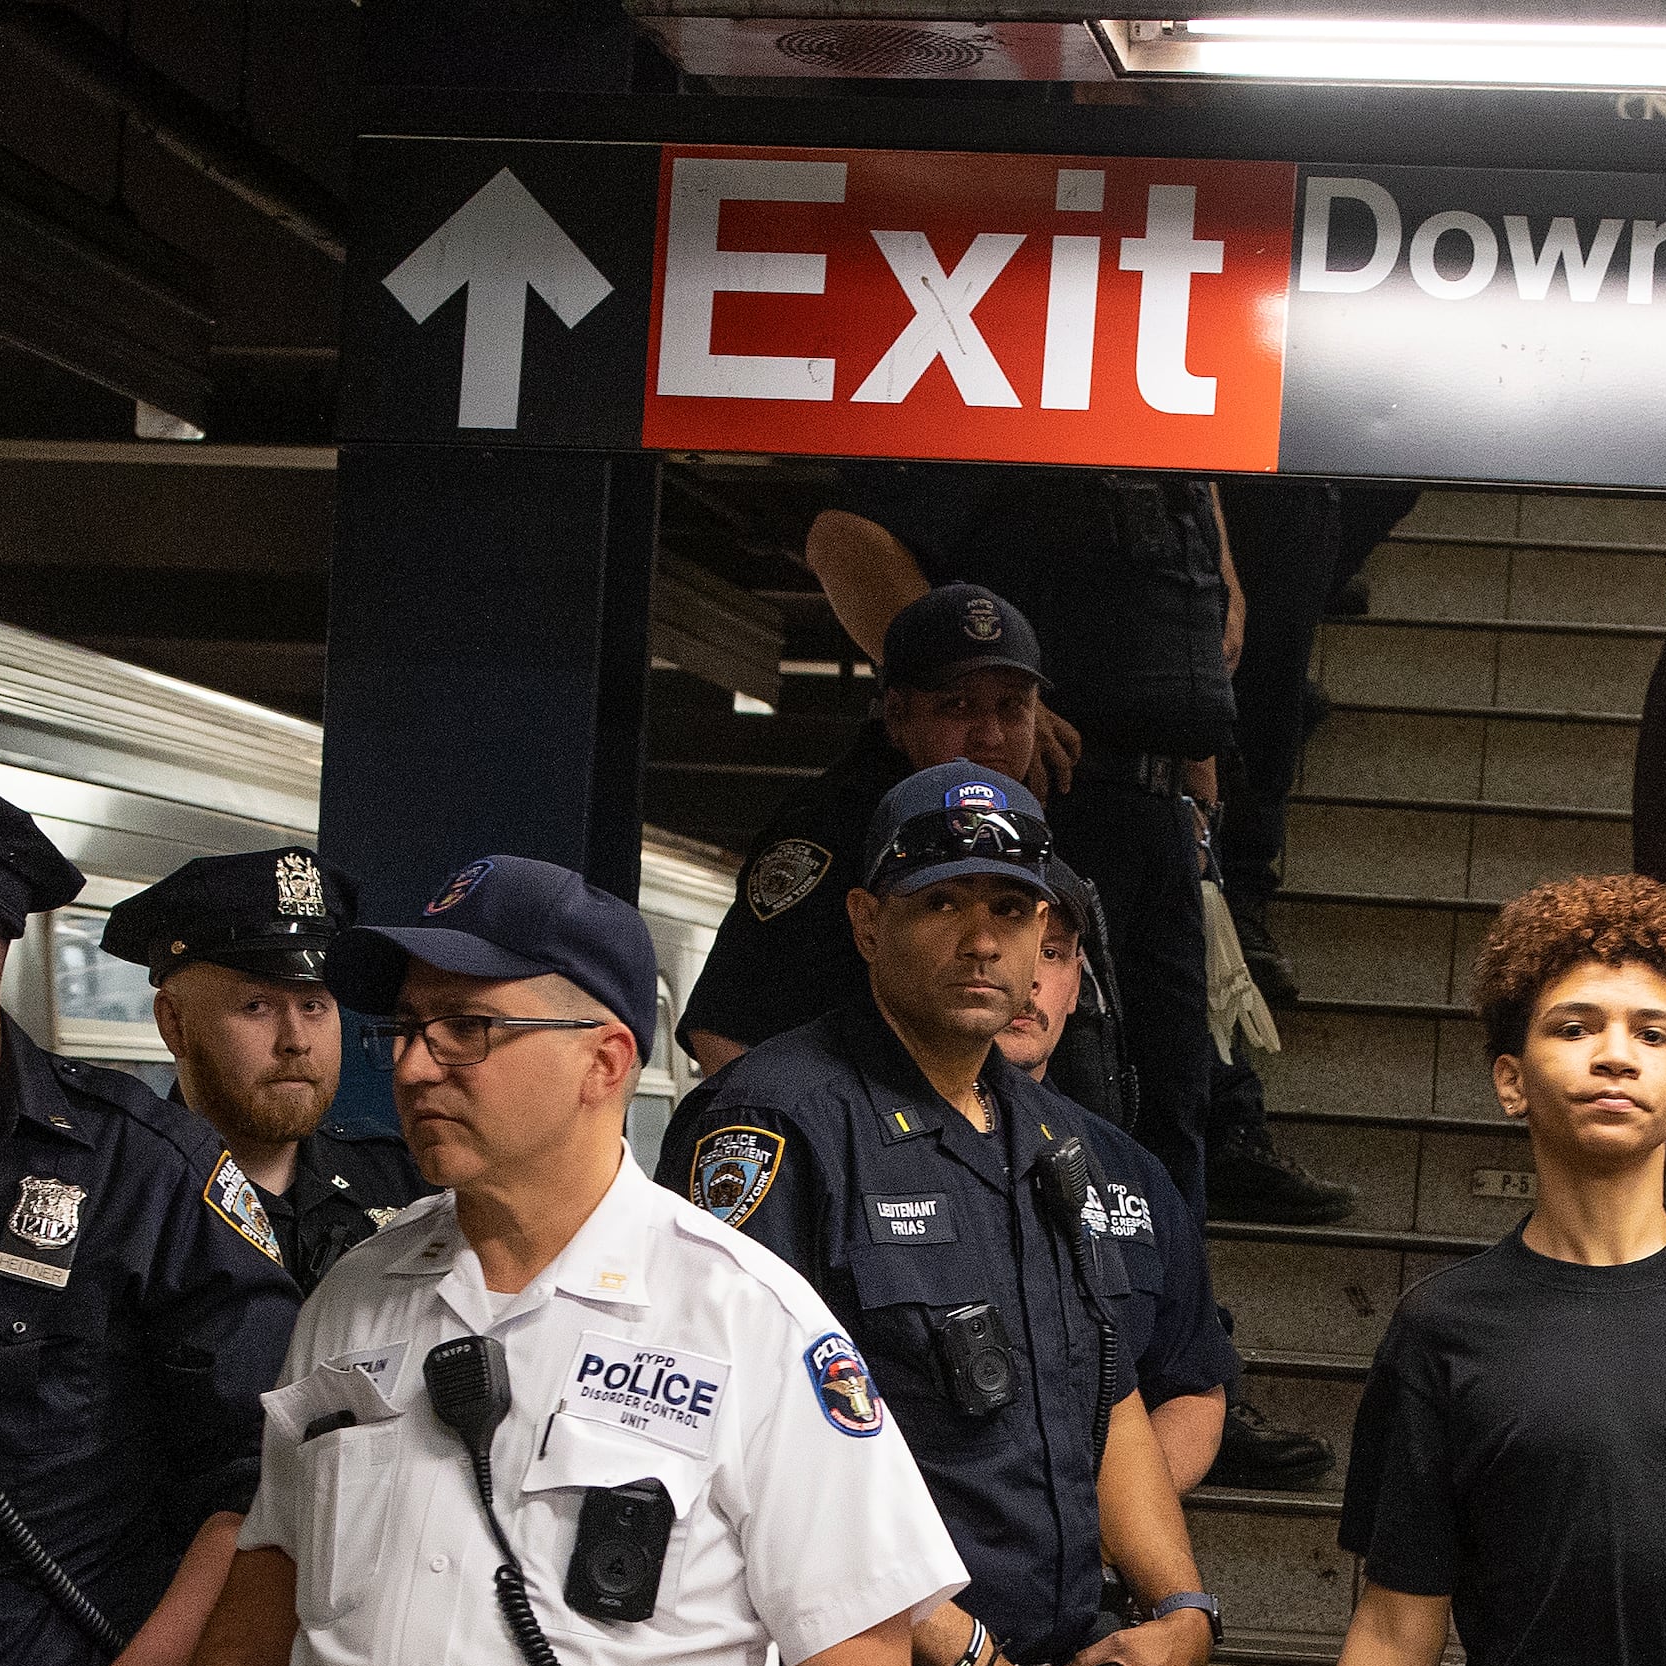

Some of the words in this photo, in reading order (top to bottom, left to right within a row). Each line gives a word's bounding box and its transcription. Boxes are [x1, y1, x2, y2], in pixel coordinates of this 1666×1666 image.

[656, 157, 1225, 416] Exit
[959, 785, 994, 799] NYPD
[714, 1134, 758, 1149] POLICE
[698, 1144, 773, 1169] DEPARTMENT
[745, 1170, 773, 1204] YORK
[1501, 1174, 1530, 1195] P-5
[890, 1220, 926, 1236] FRIAS
[440, 1343, 472, 1360] NYPD
[633, 1351, 677, 1369] NYPD
[576, 1353, 719, 1418] POLICE
[580, 1385, 641, 1410] DISORDER
[643, 1400, 700, 1430] CONTROL
[620, 1410, 651, 1432] UNIT
